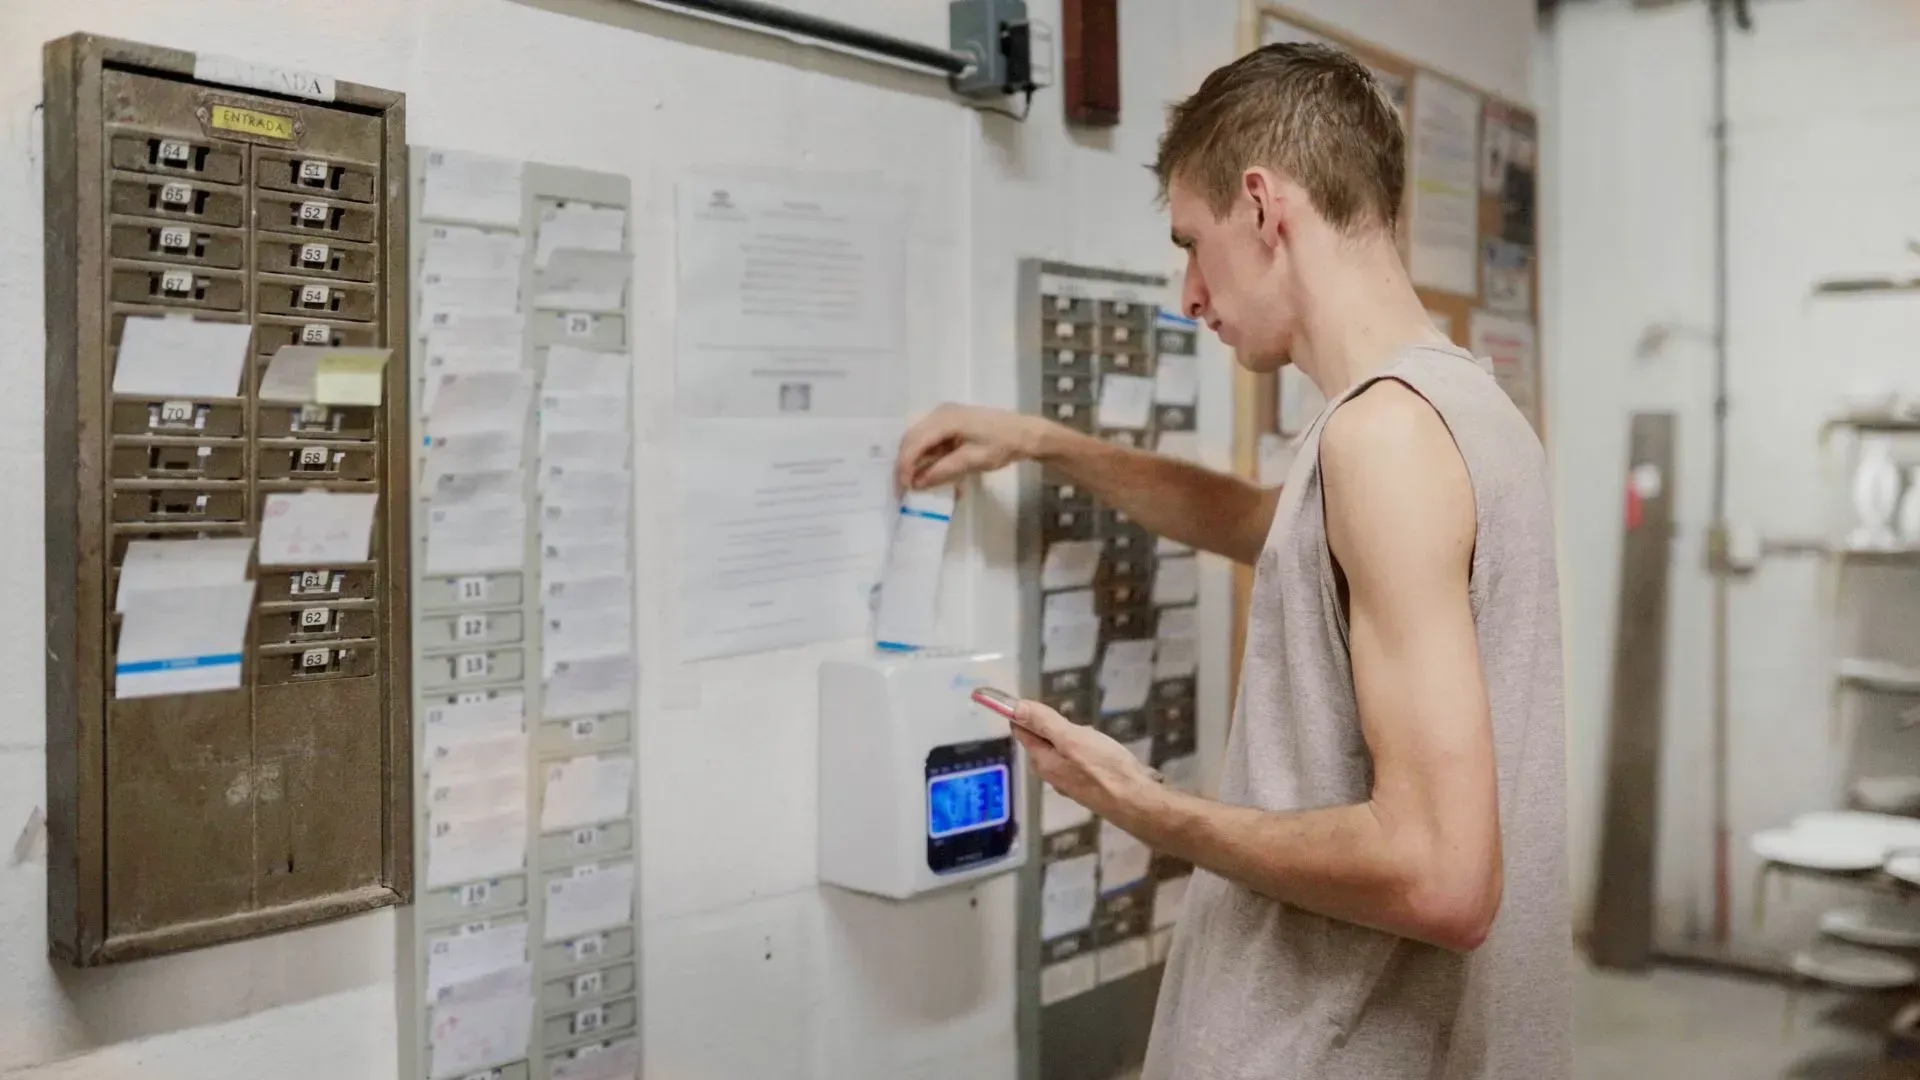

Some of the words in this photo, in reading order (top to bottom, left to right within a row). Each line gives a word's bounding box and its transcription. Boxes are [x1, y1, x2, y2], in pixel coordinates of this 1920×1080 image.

[223, 109, 285, 134] ENTRADA
[163, 144, 181, 159] 64
[304, 165, 321, 177] 51
[165, 187, 184, 202] 65
[305, 207, 321, 219] 52
[164, 232, 183, 245] 66
[305, 248, 321, 261] 53
[166, 277, 185, 290] 67
[305, 290, 321, 301] 54
[306, 329, 323, 341] 55
[167, 408, 185, 420] 70
[304, 452, 320, 464] 58
[305, 576, 320, 587] 61
[464, 582, 481, 598] 11
[305, 612, 322, 624] 62
[465, 620, 482, 635] 12
[306, 655, 323, 666] 63
